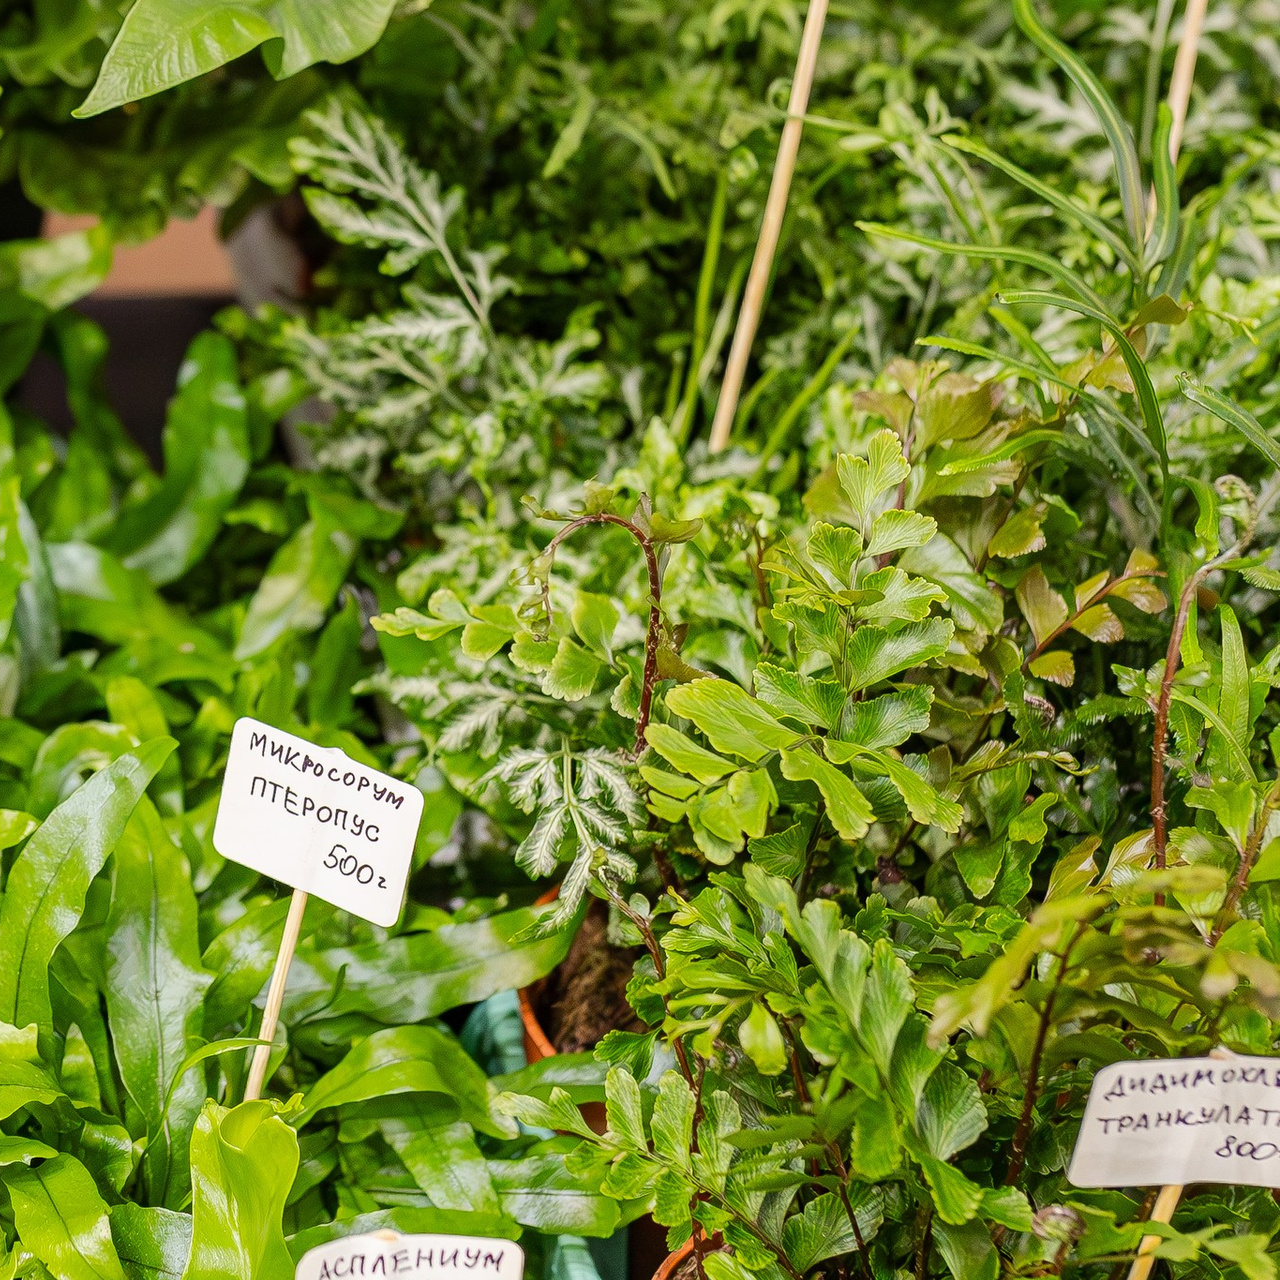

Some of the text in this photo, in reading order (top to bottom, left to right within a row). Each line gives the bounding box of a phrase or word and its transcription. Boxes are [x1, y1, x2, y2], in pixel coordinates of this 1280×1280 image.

[249, 731, 405, 810] МИКРОСОРУМ
[250, 776, 380, 842] ПТЕРОПУС
[1096, 1104, 1280, 1136] ТРАНКУЛАТ
[1215, 1135, 1280, 1161] 800
